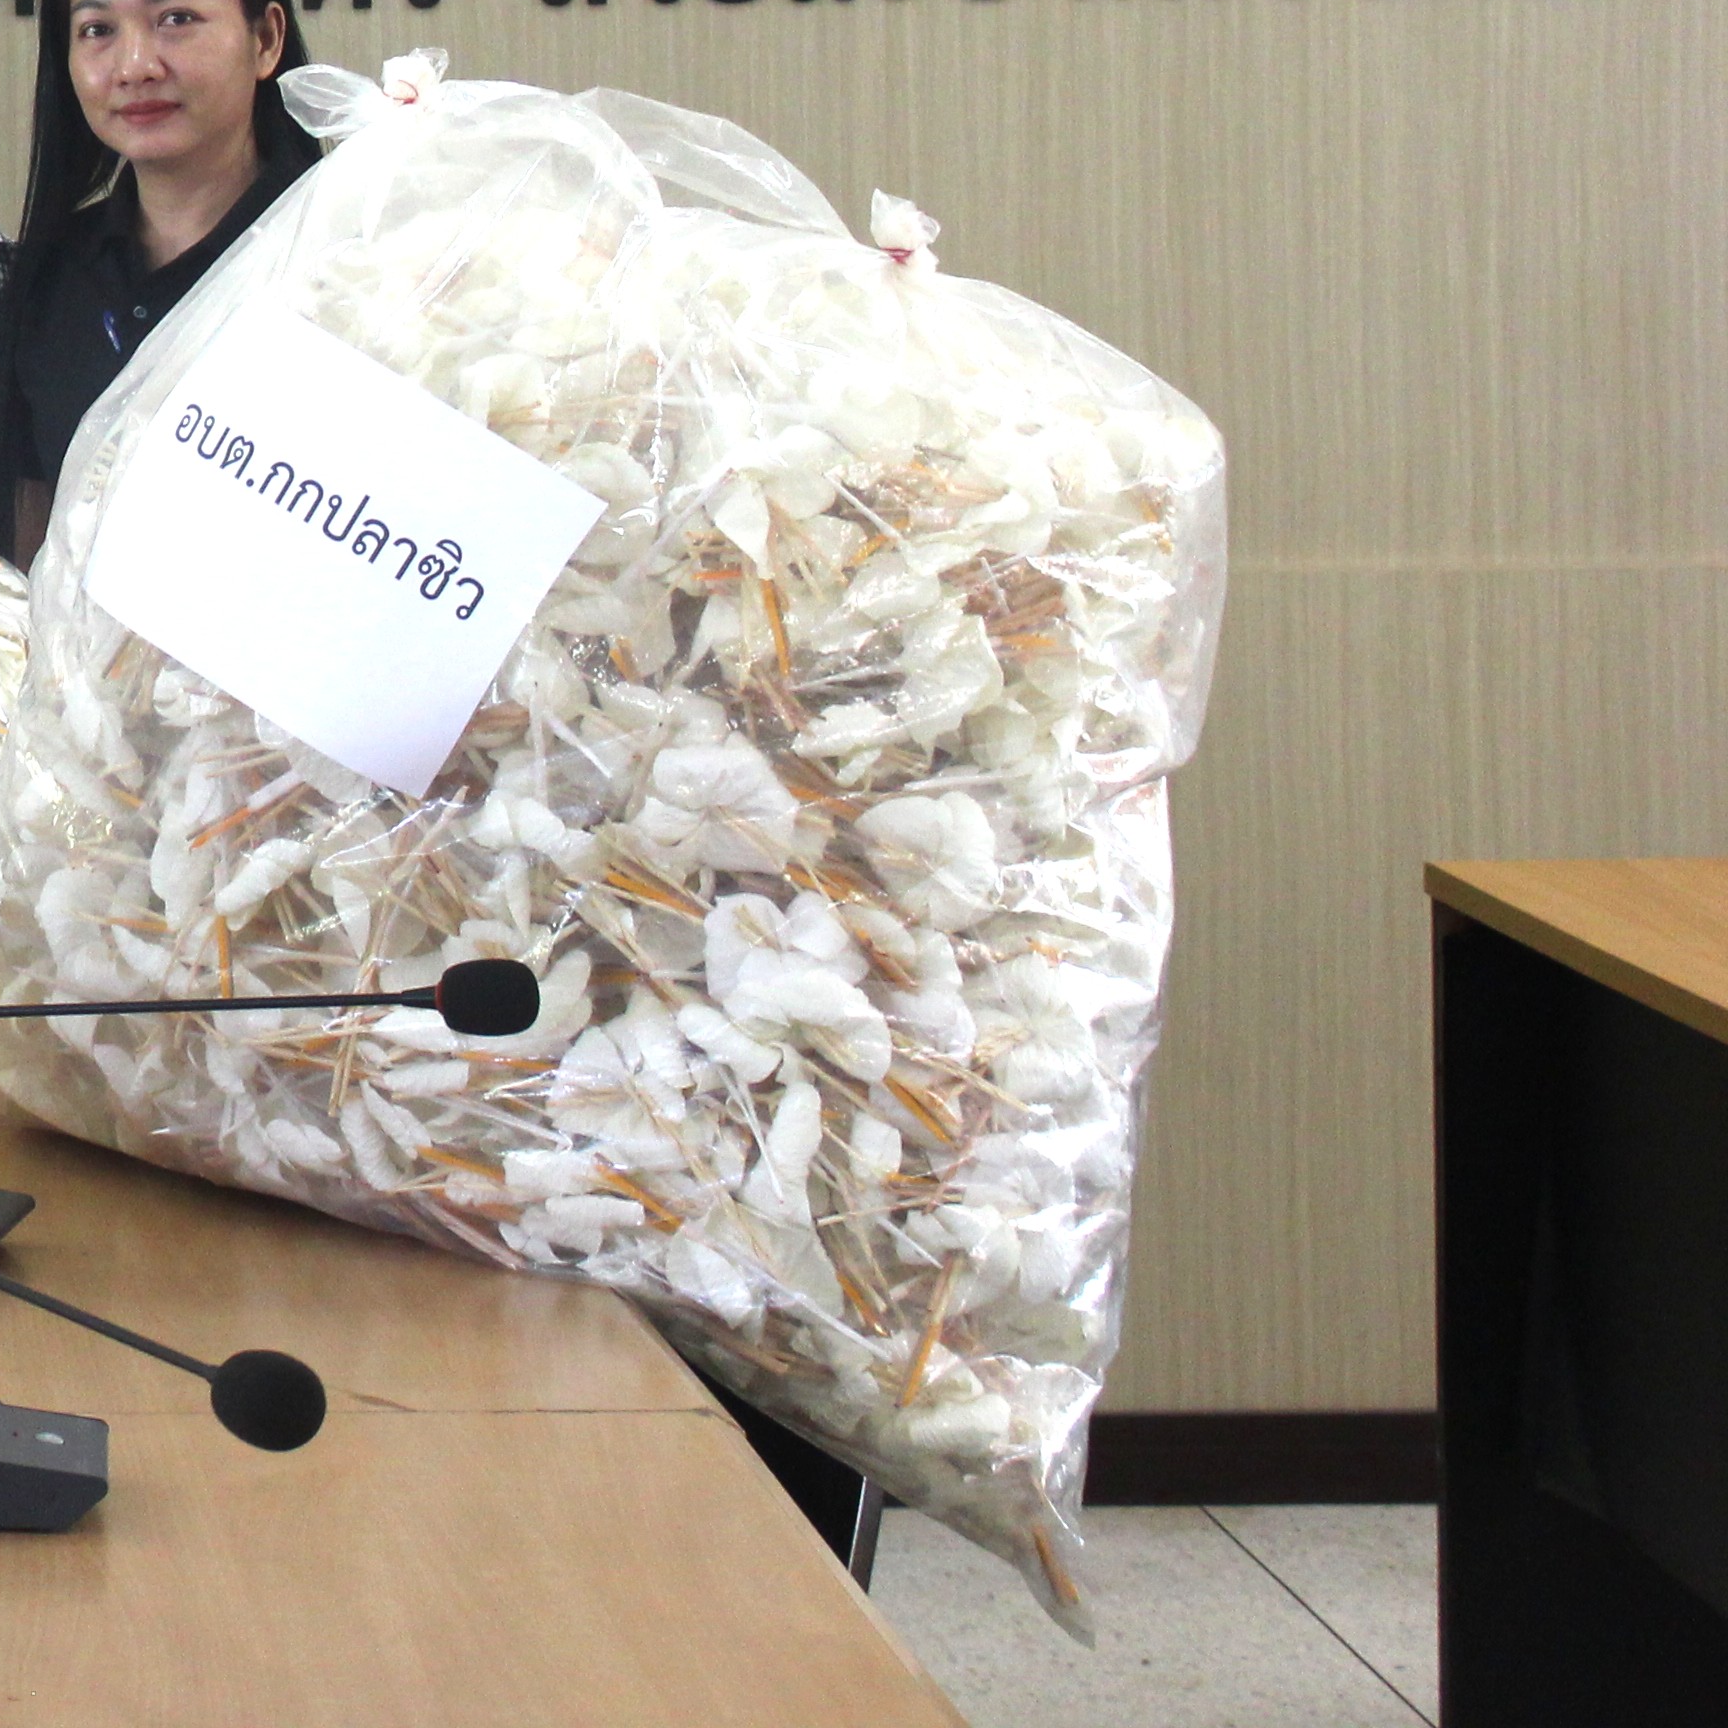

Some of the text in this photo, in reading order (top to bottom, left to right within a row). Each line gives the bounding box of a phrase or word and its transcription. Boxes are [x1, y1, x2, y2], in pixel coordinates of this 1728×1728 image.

[175, 404, 485, 621] อบต.กกปลาซิว
